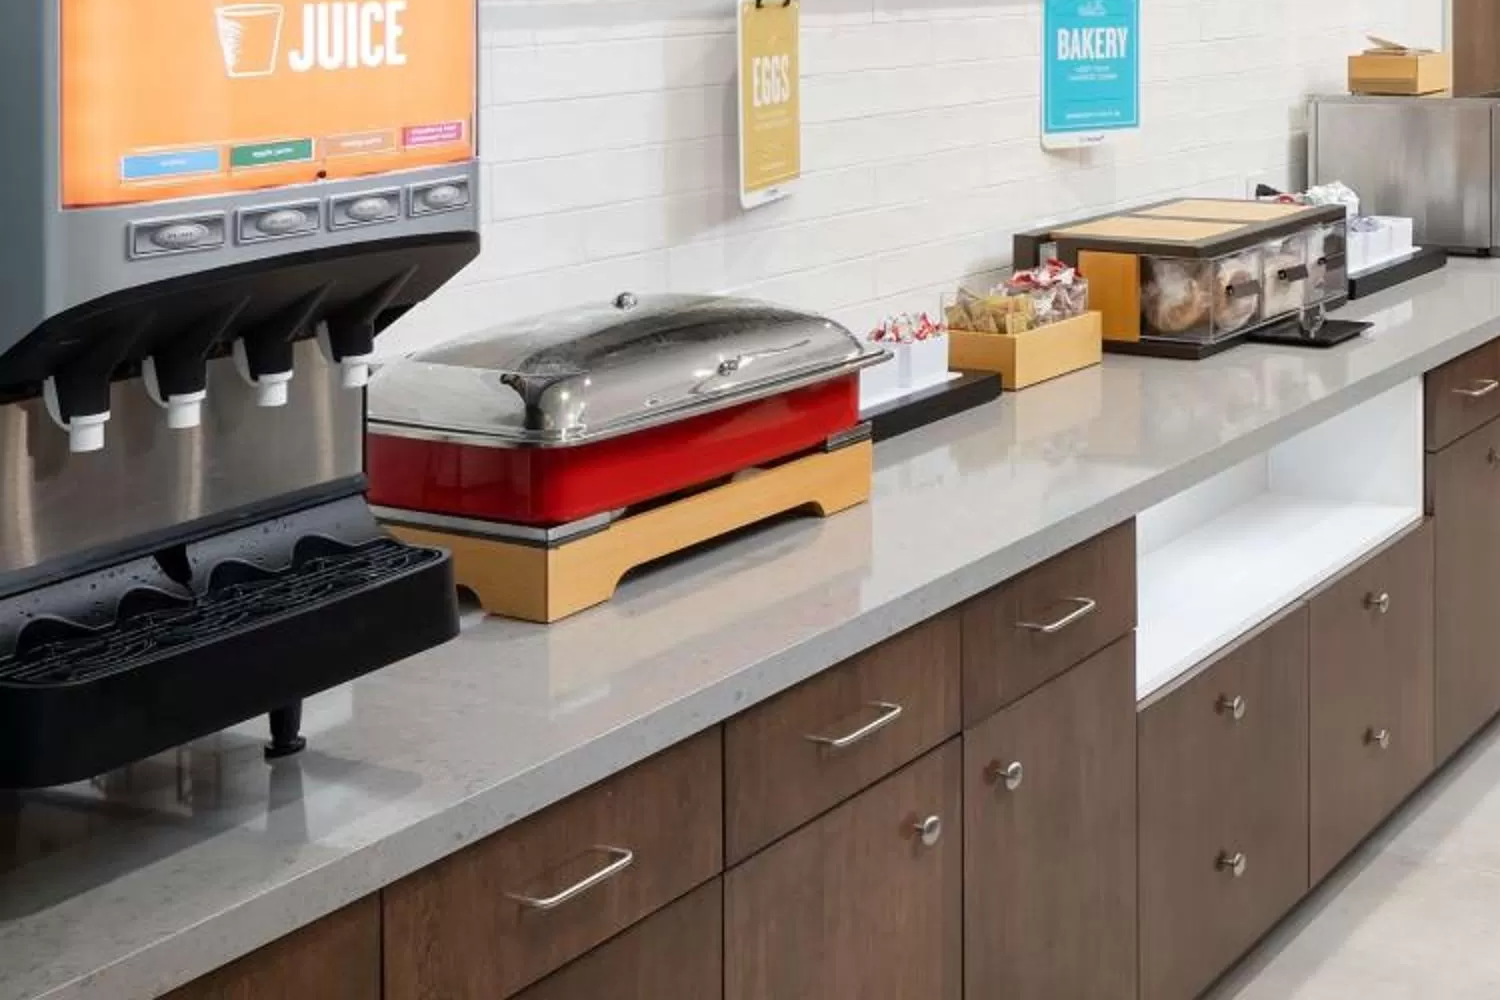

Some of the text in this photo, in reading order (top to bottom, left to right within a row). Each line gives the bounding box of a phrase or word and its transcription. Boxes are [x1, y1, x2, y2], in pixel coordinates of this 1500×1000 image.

[288, 0, 407, 72] JUICE
[1056, 26, 1128, 60] BAKERY
[752, 55, 790, 107] EGGS
